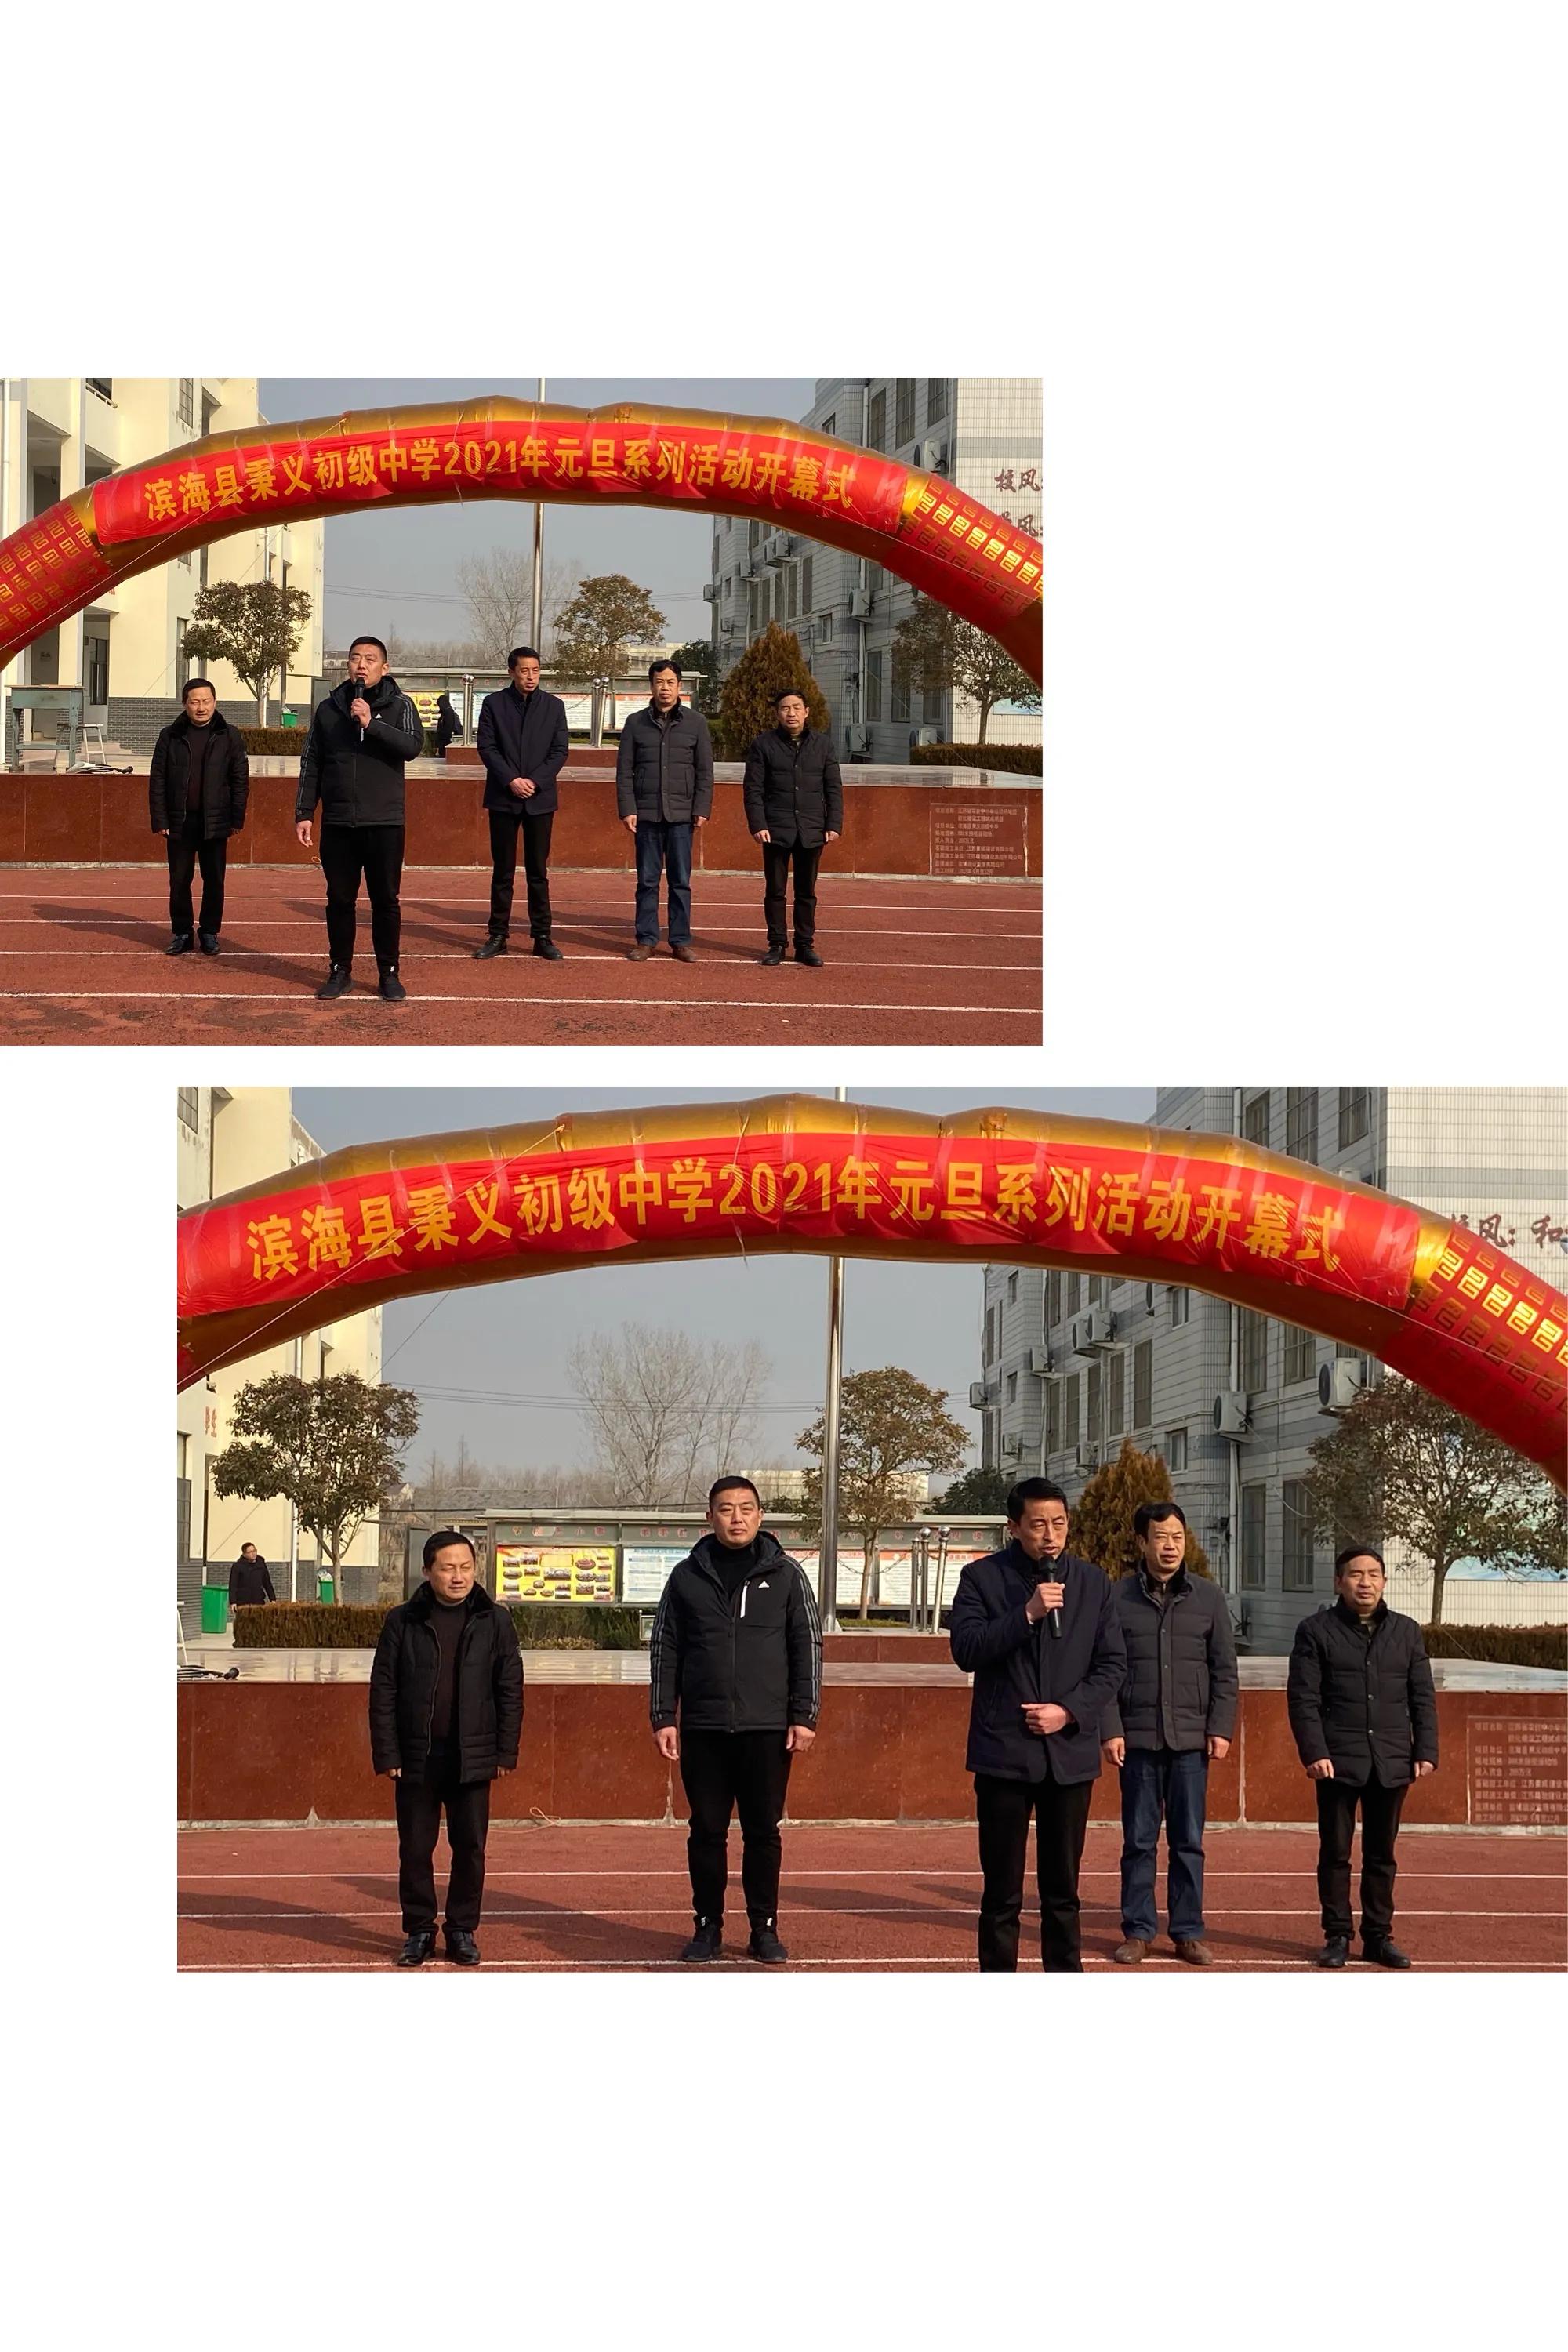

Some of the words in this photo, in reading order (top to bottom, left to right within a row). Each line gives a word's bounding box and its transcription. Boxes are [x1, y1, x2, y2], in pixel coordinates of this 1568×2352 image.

[143, 436, 857, 521] 滨海县秉义初级中学2021年元旦系列活动开幕式
[246, 1156, 1345, 1281] 滨海县秉义初级中学2021年元旦系列活动开幕式
